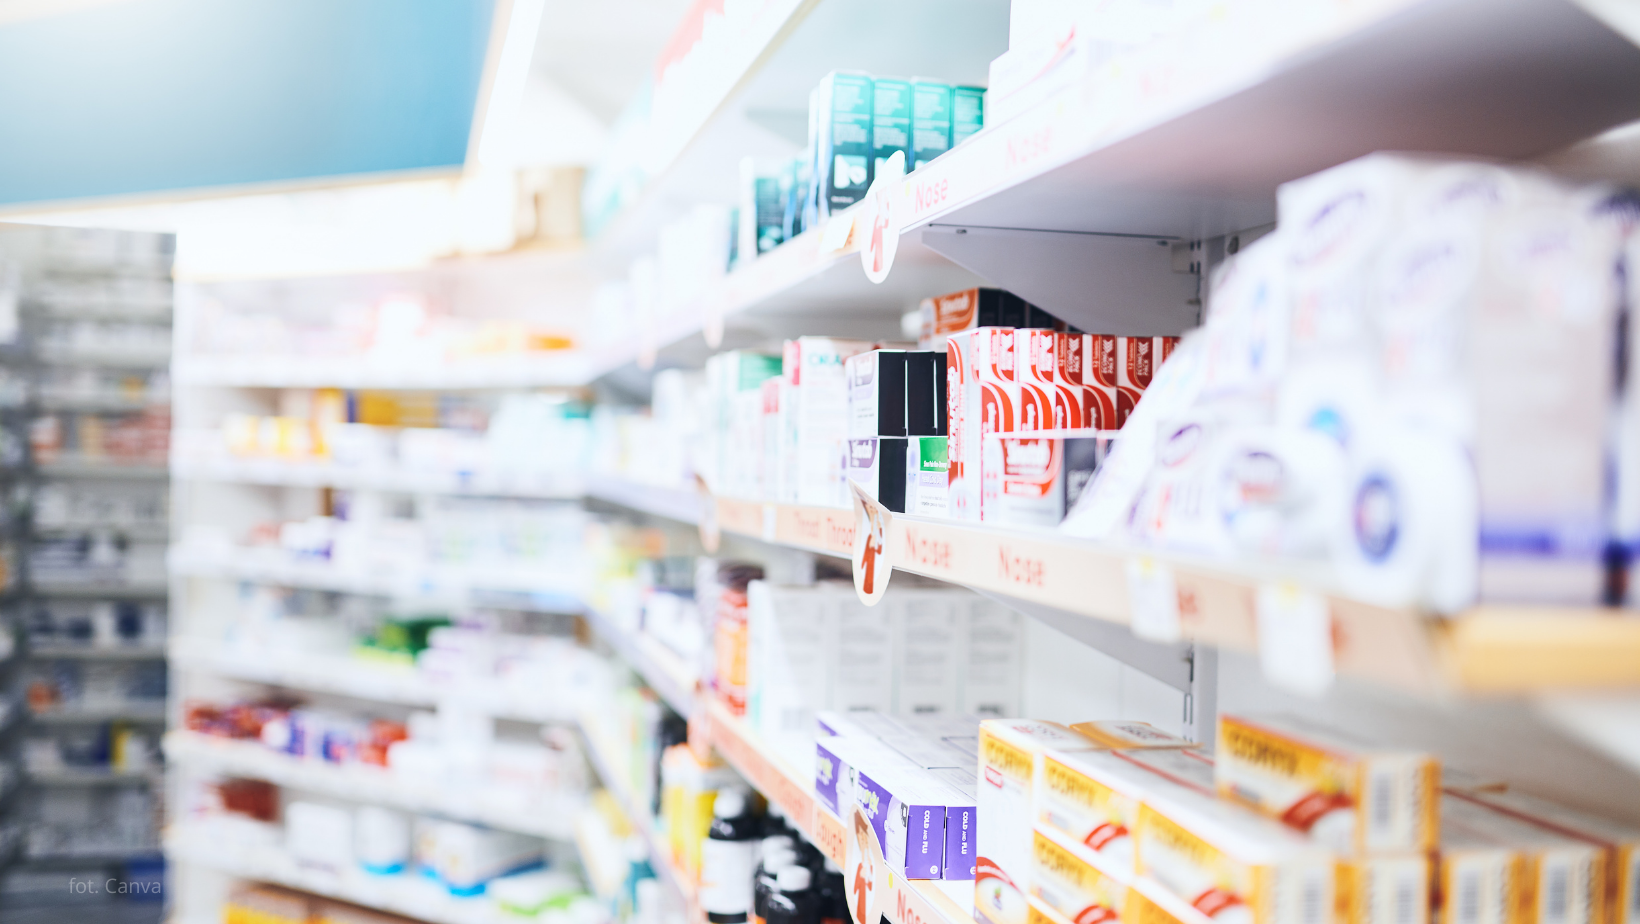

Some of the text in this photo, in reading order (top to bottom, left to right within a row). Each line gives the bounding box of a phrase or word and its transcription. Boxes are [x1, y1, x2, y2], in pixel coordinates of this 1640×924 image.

[915, 178, 948, 214] Nose
[905, 527, 953, 570] Nose
[998, 544, 1046, 588] Nose
[923, 810, 931, 829] COLD
[921, 841, 929, 854] FLU
[897, 888, 928, 924] No
